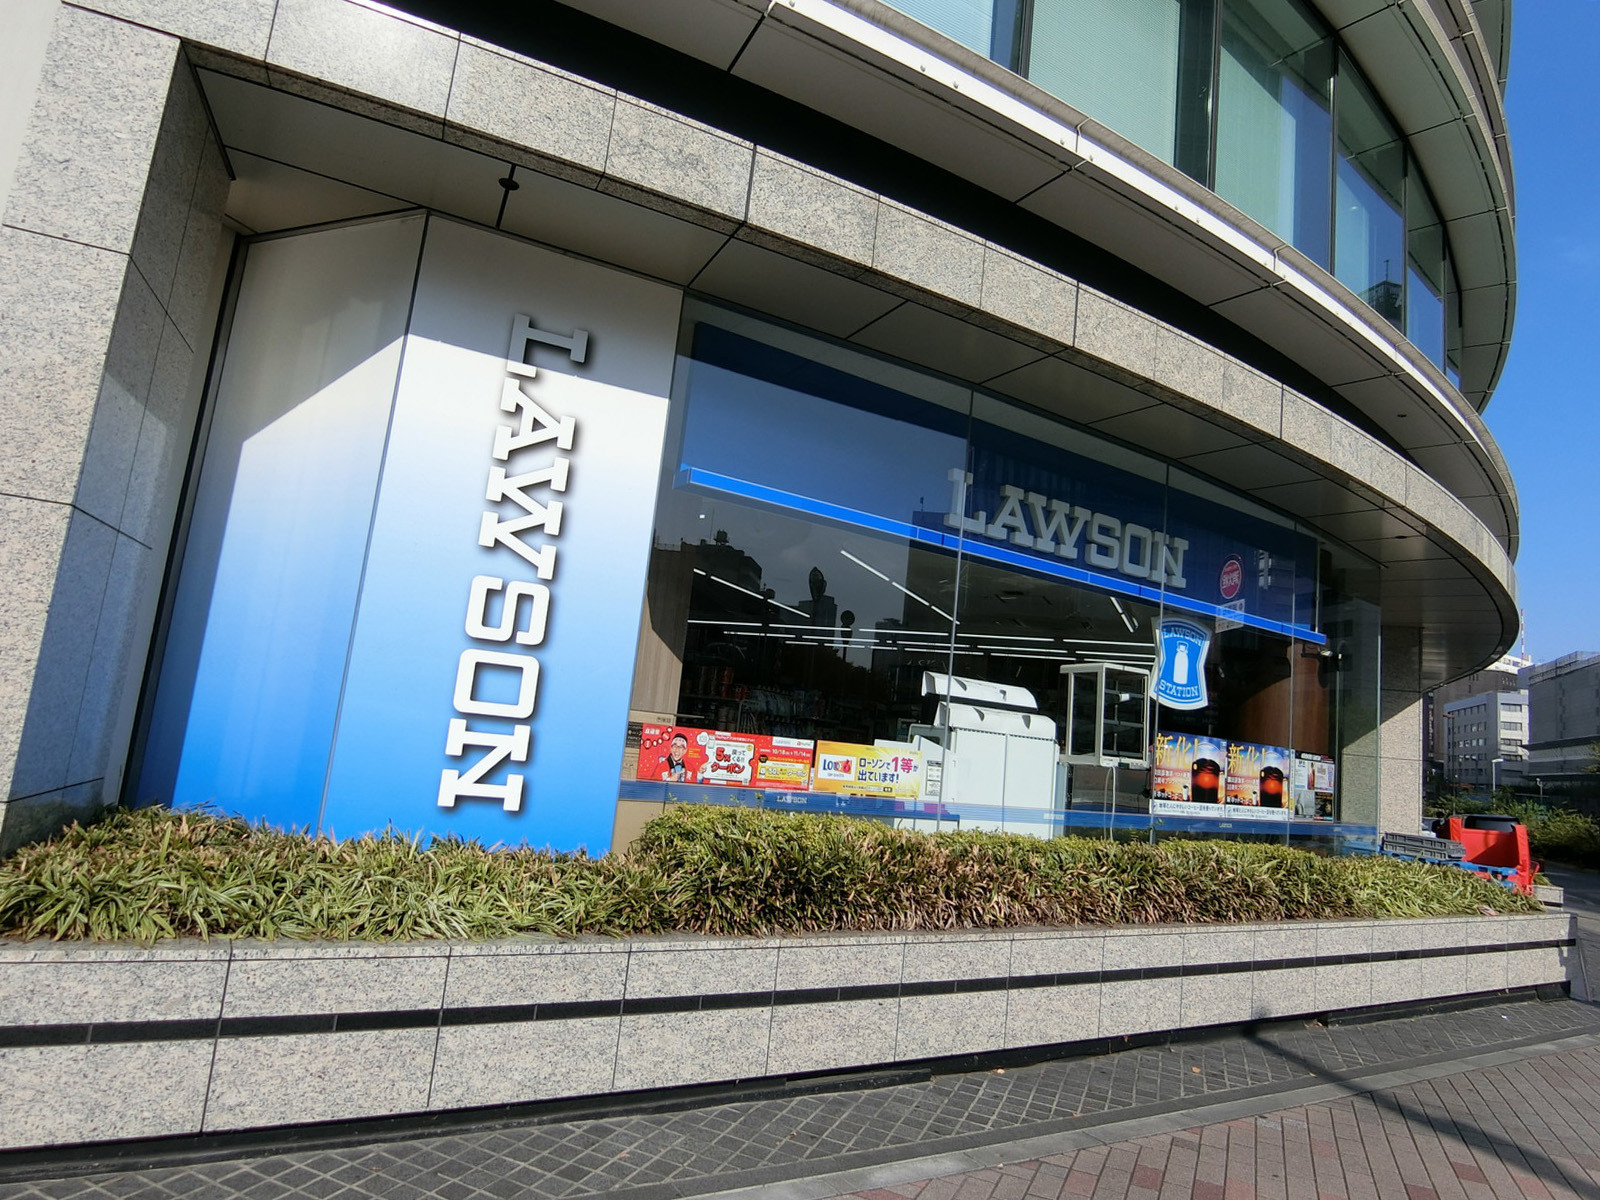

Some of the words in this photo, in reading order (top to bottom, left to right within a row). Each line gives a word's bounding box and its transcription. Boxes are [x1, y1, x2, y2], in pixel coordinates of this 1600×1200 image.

[944, 468, 1189, 588] LAWSON
[437, 313, 589, 812] LAWSON
[1162, 627, 1204, 647] LAWSON
[1159, 679, 1199, 697] STATION
[711, 762, 745, 774] クーポン
[858, 770, 900, 783] 出ています!
[776, 795, 807, 804] LAWSON
